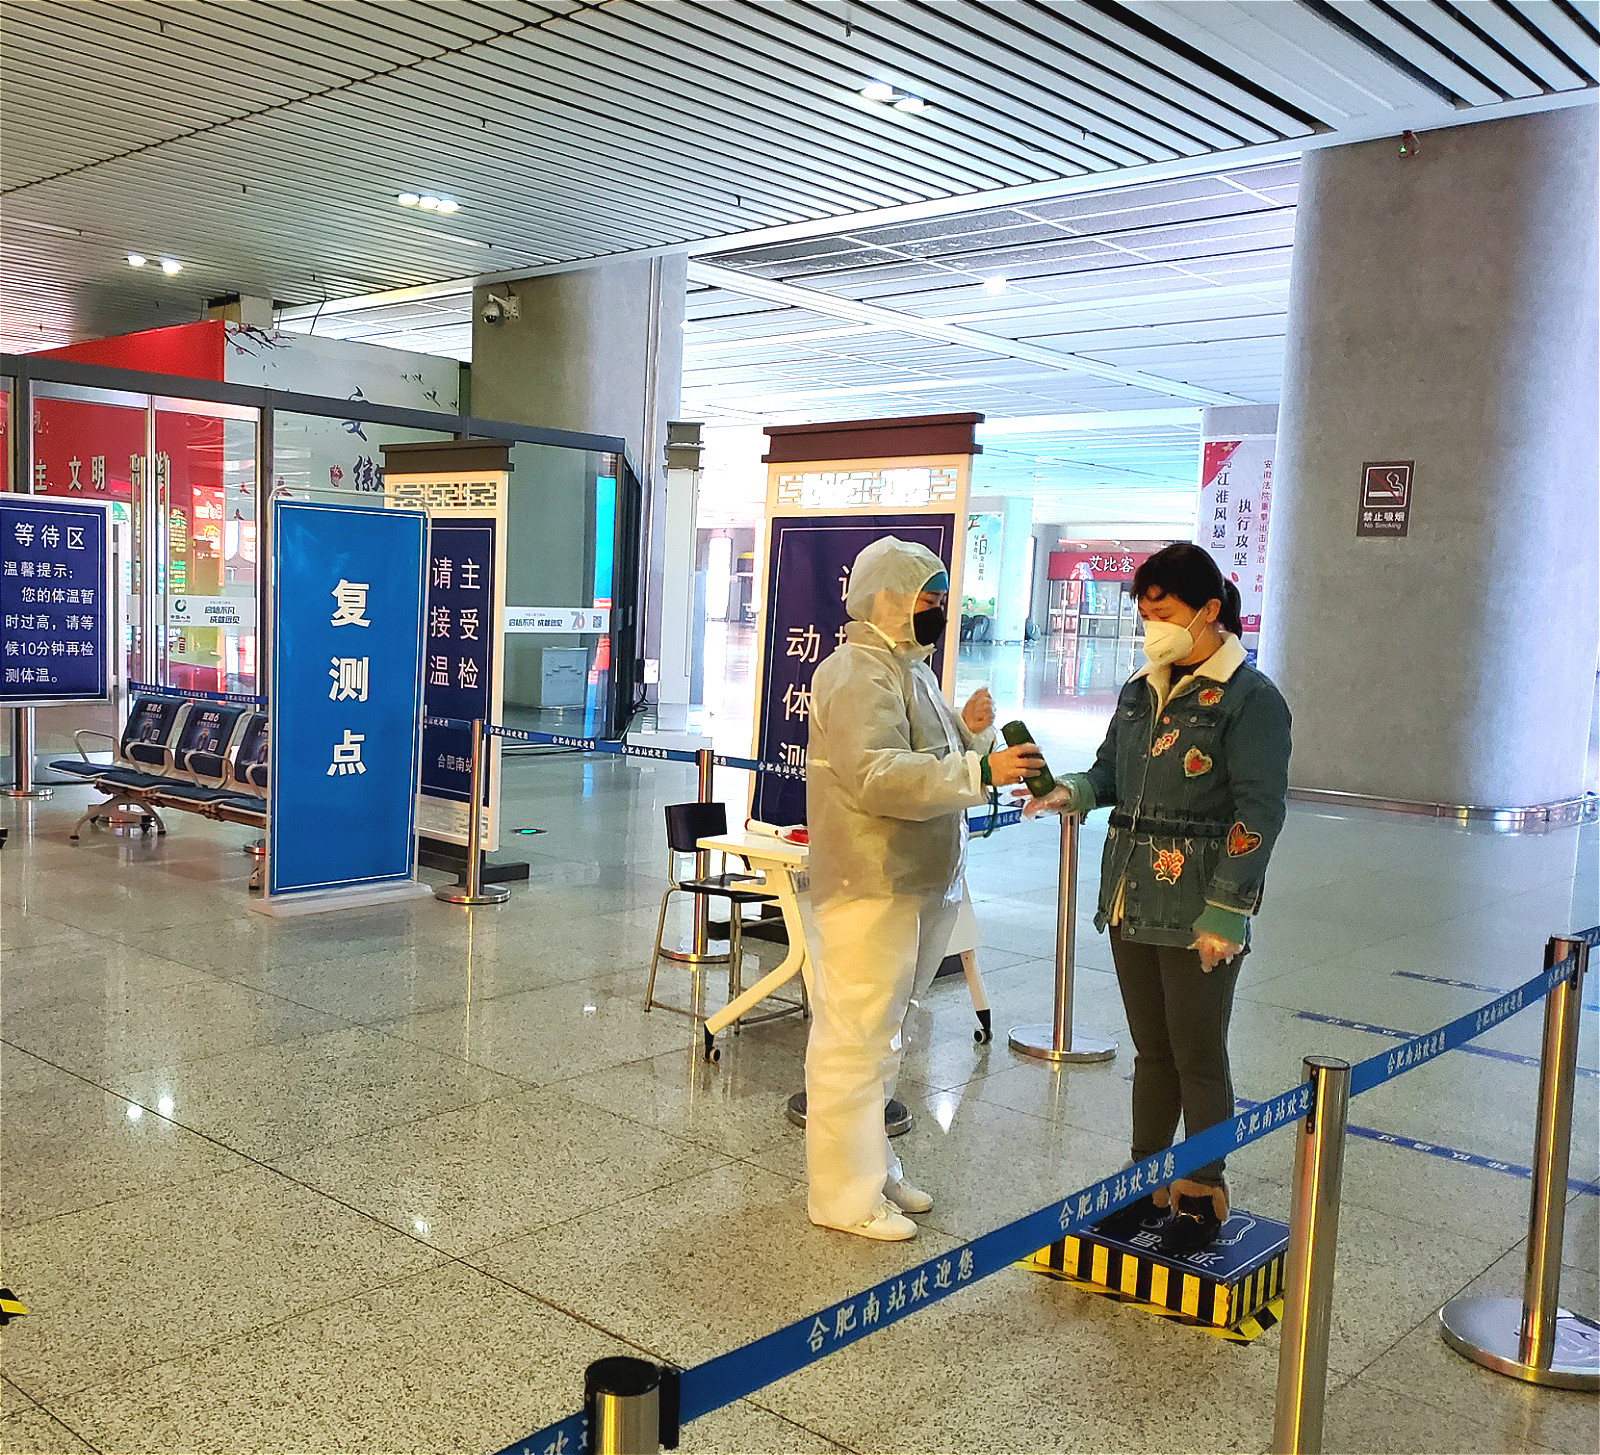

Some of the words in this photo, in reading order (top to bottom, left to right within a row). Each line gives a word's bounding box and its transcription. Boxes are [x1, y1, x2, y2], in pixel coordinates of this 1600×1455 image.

[69, 456, 106, 491] 文明
[1363, 511, 1405, 522] 禁止吸烟
[1234, 499, 1252, 566] 执行攻坚
[1375, 522, 1402, 530] Smoking
[14, 522, 85, 550] 等待区
[3, 560, 73, 579] 温馨提示：
[1089, 555, 1135, 573] 艾比客
[21, 587, 95, 605] 您的体温暂
[5, 613, 94, 631] 时过高，请等
[4, 640, 94, 657] 候10分钟再检
[5, 667, 58, 683] 测体温。
[327, 578, 371, 776] 复测点
[489, 726, 529, 740] 合肥南站欢迎您
[552, 735, 595, 750] 合肥南站欢迎您
[621, 745, 668, 759] 合肥南站欢迎您
[437, 753, 473, 773] 合肥南站
[1387, 1032, 1445, 1075] 合肥南站欢迎您
[1234, 1089, 1313, 1144] 合肥南站欢迎
[1057, 1151, 1176, 1231] 合肥南站欢迎您
[806, 1248, 975, 1354] 合肥南站欢迎您
